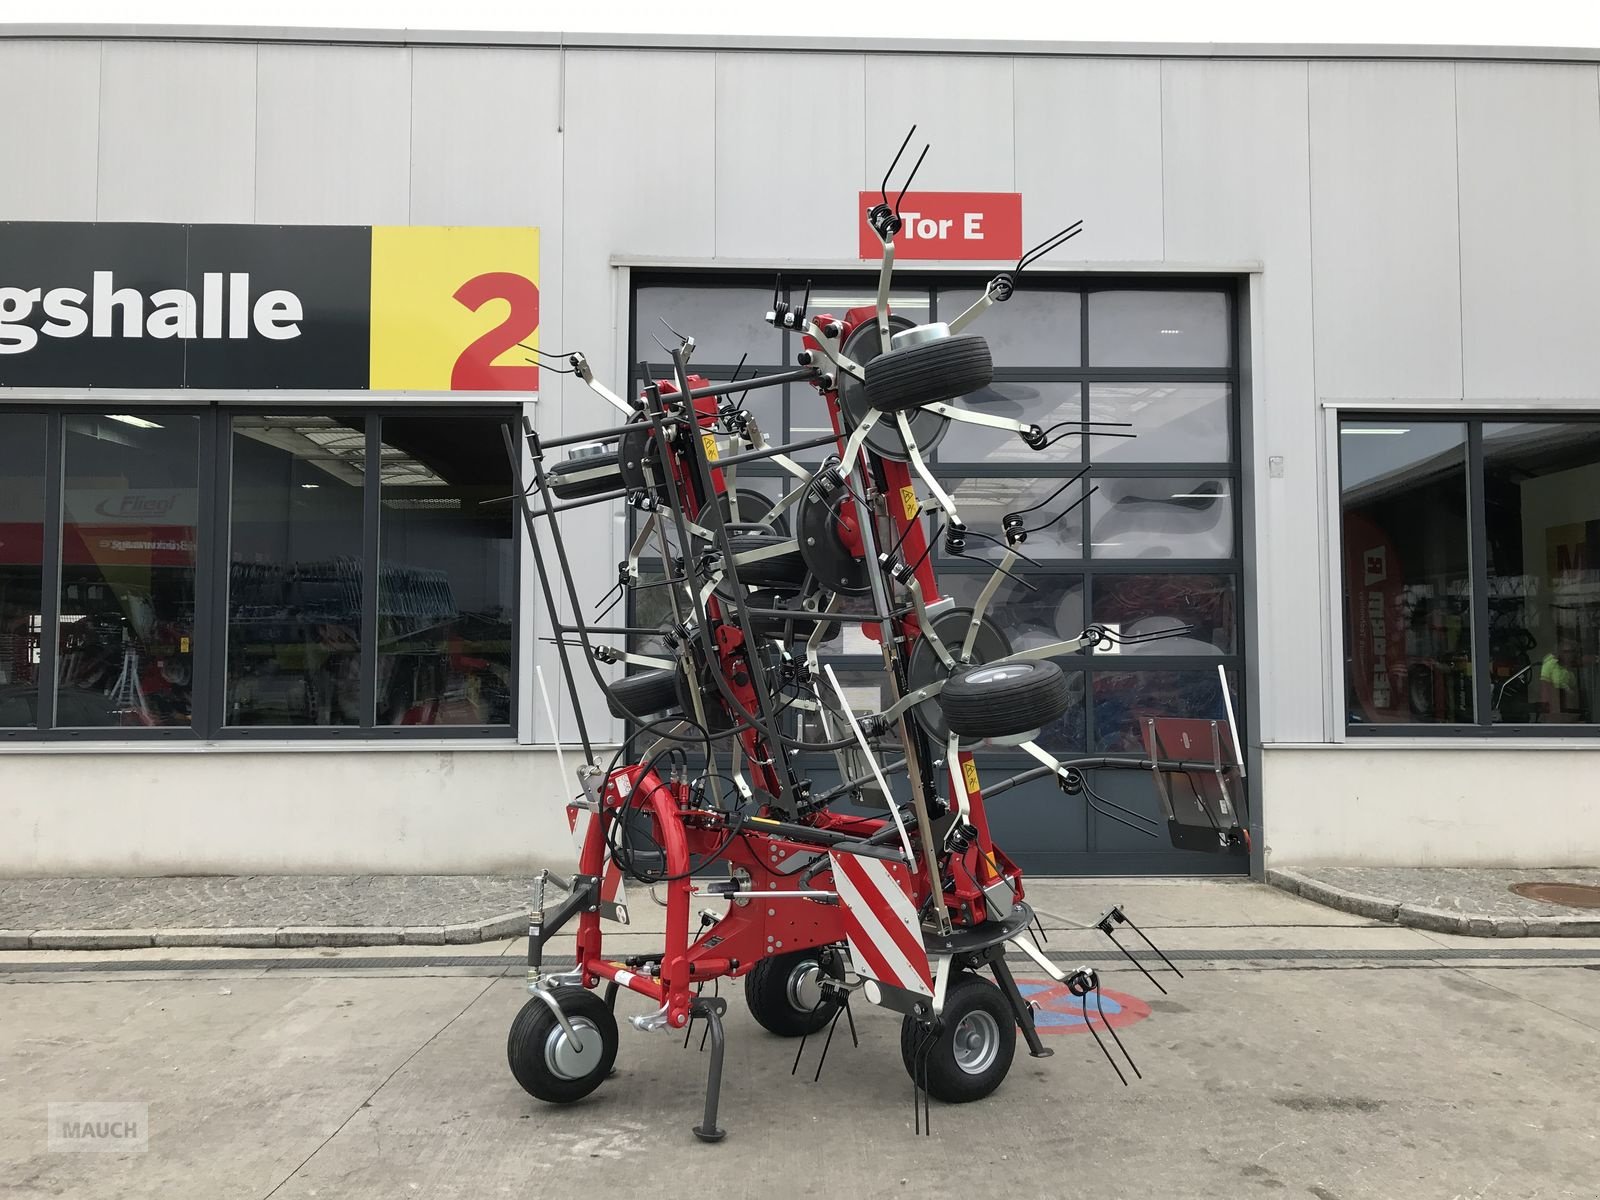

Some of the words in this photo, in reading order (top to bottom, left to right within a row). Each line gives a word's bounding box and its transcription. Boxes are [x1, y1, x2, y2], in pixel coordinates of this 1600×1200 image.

[899, 212, 952, 240] Tor
[964, 212, 984, 240] E
[0, 271, 303, 354] gshalle
[451, 271, 539, 391] 2
[121, 495, 176, 514] Fliegl
